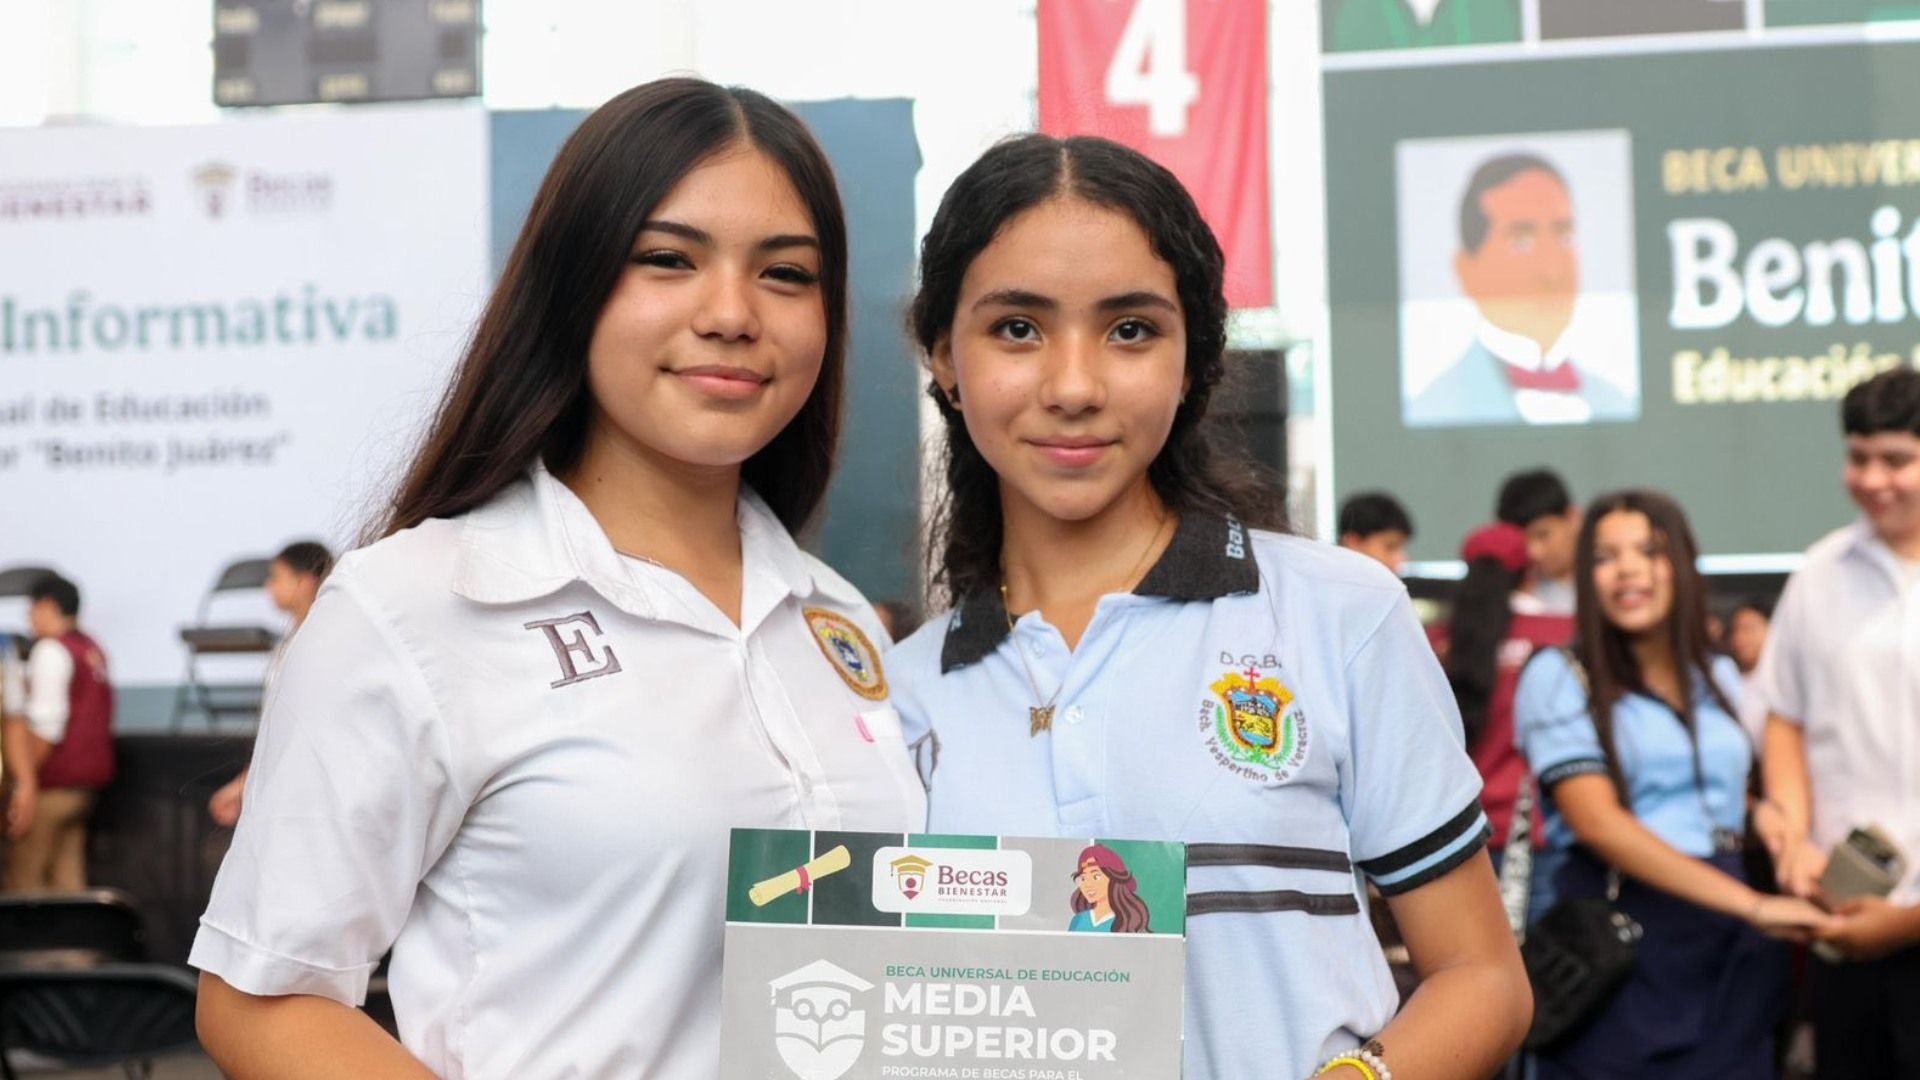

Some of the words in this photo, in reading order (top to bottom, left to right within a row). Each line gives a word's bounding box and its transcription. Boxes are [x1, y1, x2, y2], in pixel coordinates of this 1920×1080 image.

[1104, 0, 1199, 137] 4
[1663, 148, 1768, 194] BECA
[0, 283, 399, 353] Informativa
[1673, 343, 1902, 404] Educació
[43, 396, 80, 424] de
[524, 611, 623, 689] E
[1220, 651, 1282, 669] D.G.B.
[938, 865, 1008, 886] Becas
[938, 887, 1007, 897] BIENESTAR
[886, 965, 925, 977] BECA
[930, 966, 1013, 980] UNIVERSAL
[1017, 968, 1038, 980] DE
[1042, 968, 1130, 983] EDUCACIÓN
[883, 982, 1036, 1017] MEDIA
[881, 1023, 1117, 1061] SUPERIOR
[882, 1066, 958, 1079] PROGRAMA
[962, 1067, 979, 1079] DE
[983, 1068, 1025, 1080] BECAS
[1029, 1069, 1064, 1080] PARA
[1068, 1071, 1082, 1080] EL
